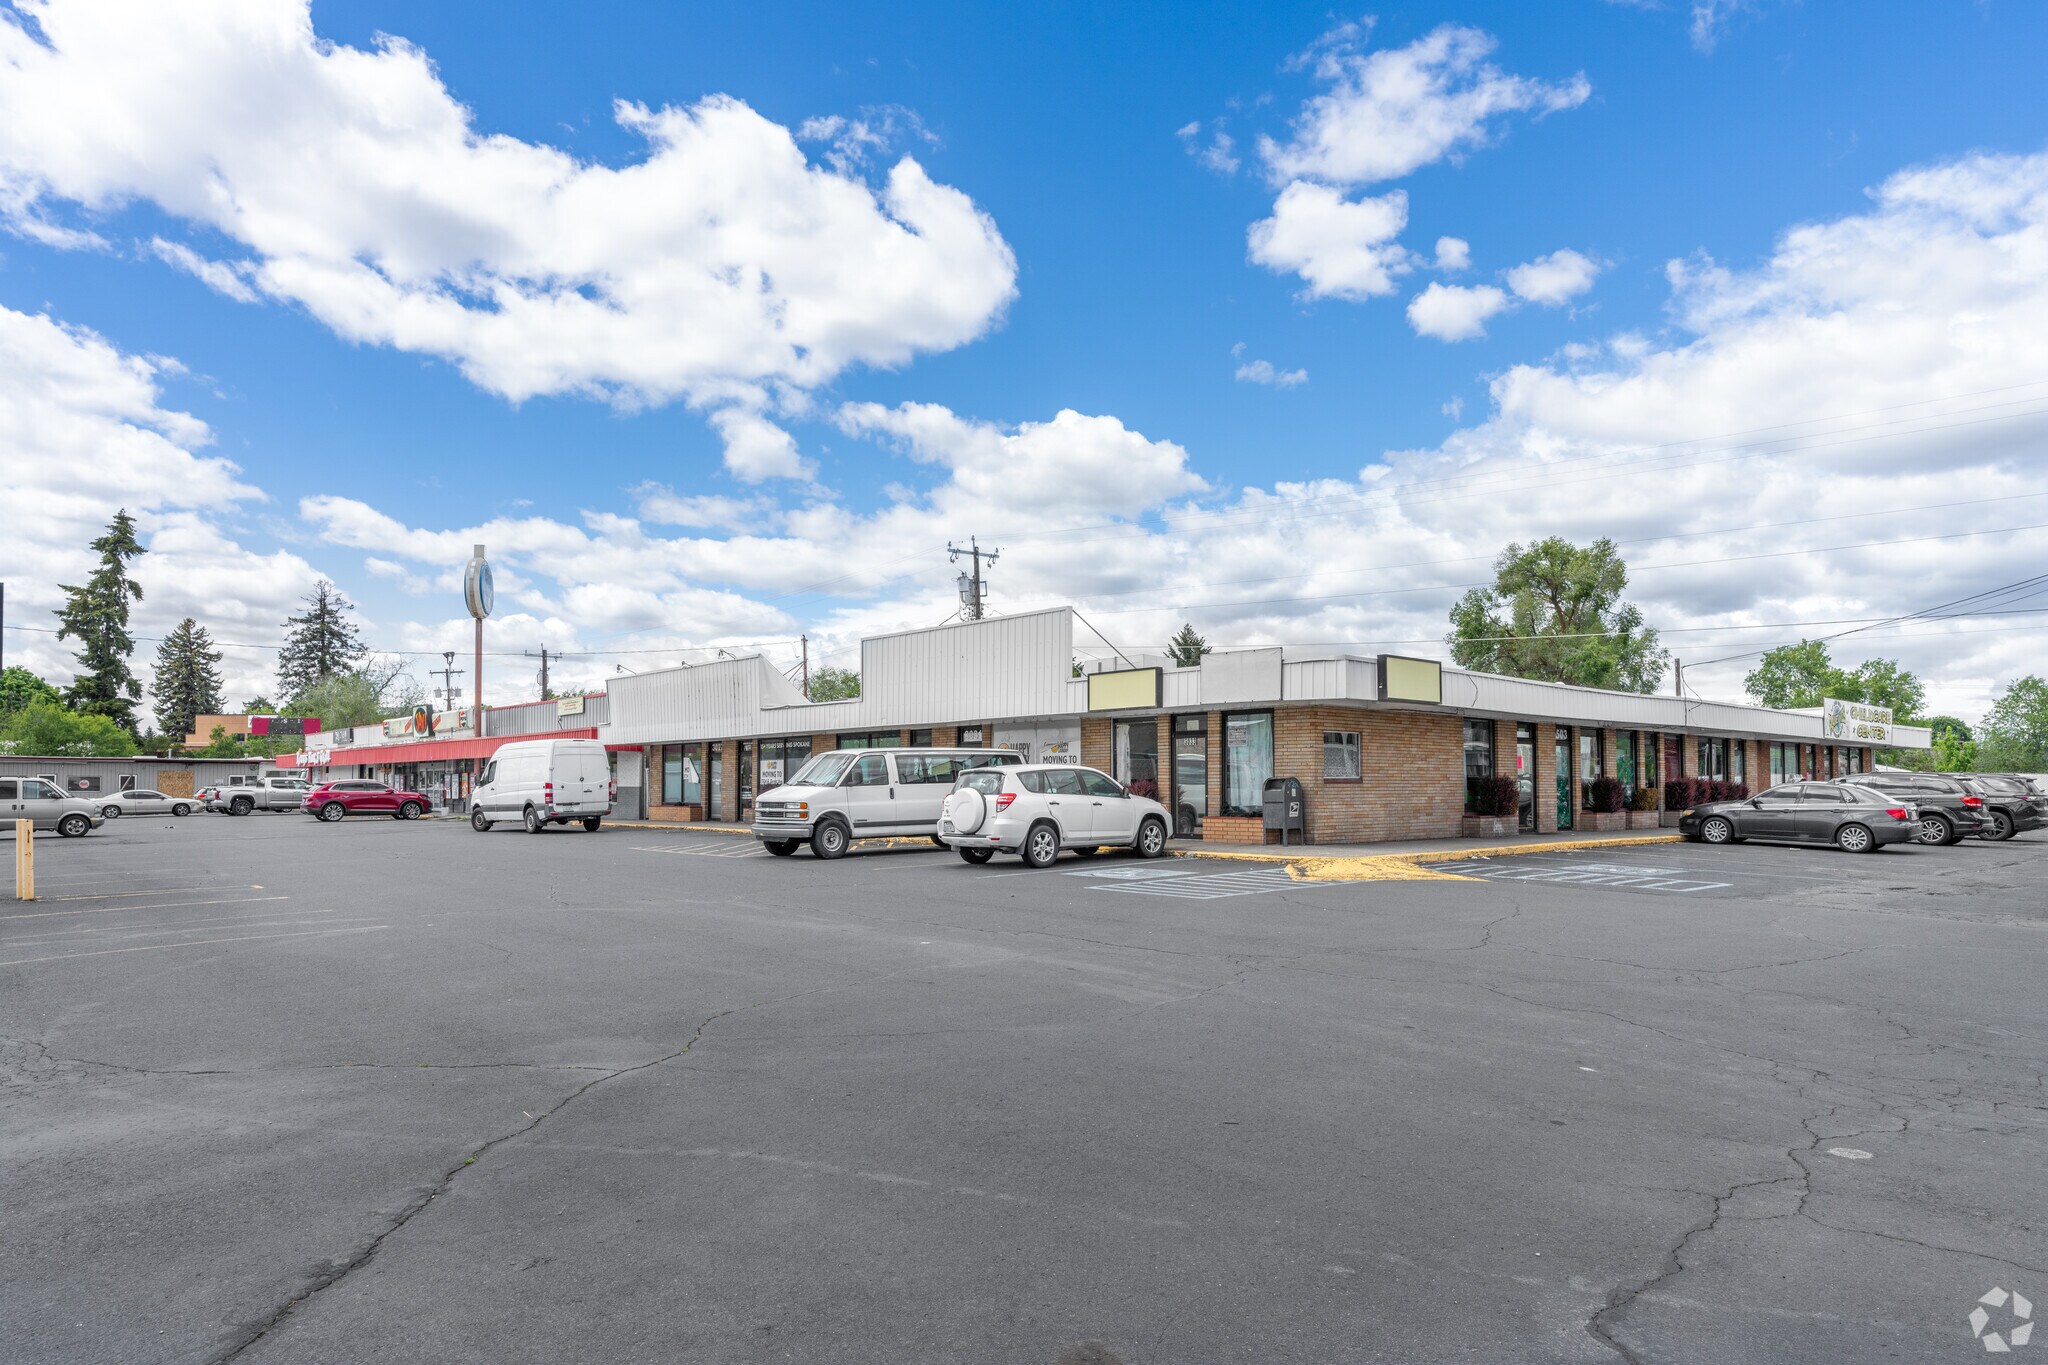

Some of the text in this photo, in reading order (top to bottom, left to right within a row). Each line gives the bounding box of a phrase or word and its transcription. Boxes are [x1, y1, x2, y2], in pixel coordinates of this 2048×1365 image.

[1850, 706, 1891, 725] CHILDCARE
[1856, 724, 1886, 741] CENTER
[1042, 755, 1078, 764] MOVING TO
